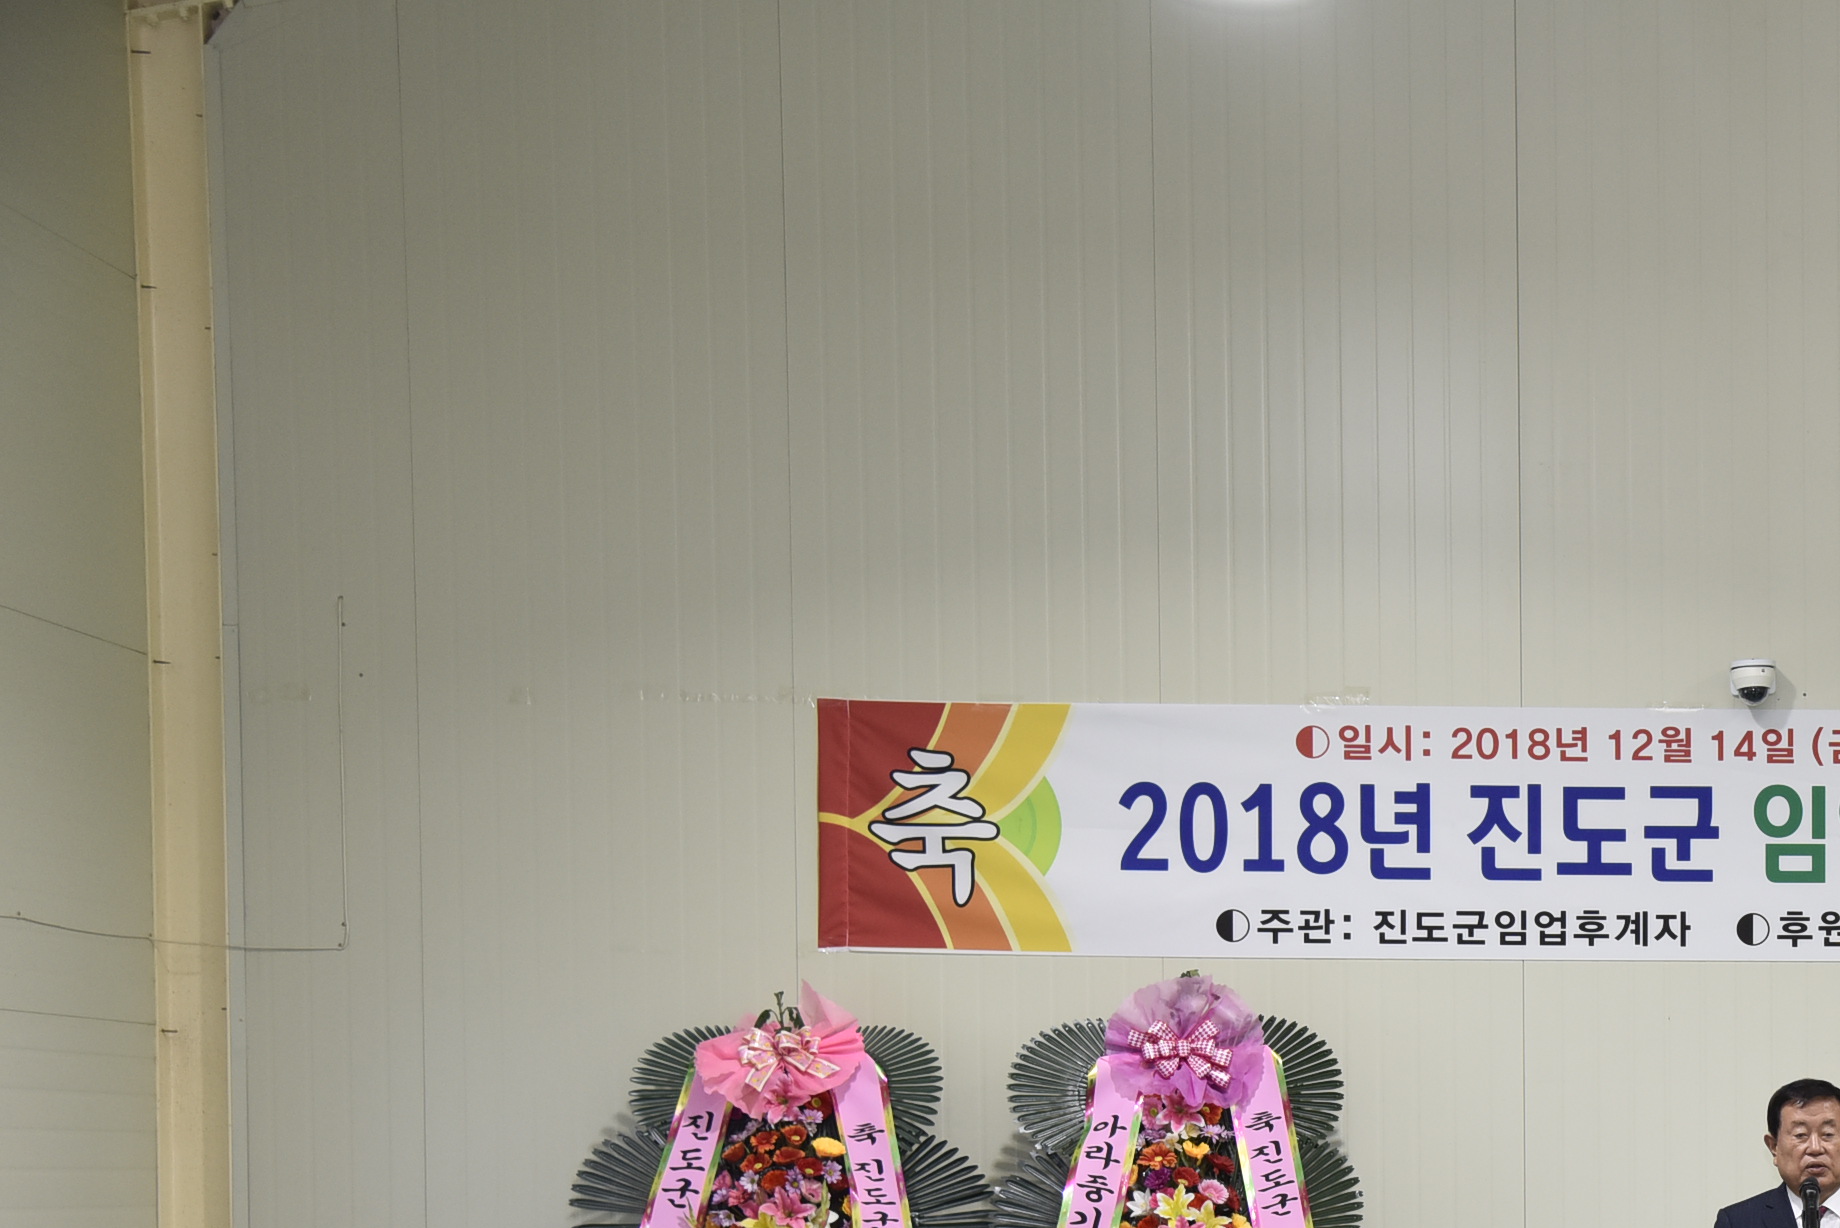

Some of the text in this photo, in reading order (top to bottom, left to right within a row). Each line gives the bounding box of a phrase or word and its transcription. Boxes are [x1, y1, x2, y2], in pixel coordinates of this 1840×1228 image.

[1338, 725, 1431, 762] 일시:
[1451, 726, 1589, 762] 2018년
[1608, 726, 1692, 764] 12월
[1711, 728, 1795, 764] 14일
[867, 747, 1000, 908] 축
[1118, 781, 1432, 882] 2018년
[1466, 783, 1720, 883] 진도군
[1256, 909, 1692, 948] 주관: 진도군임업후계자
[661, 1110, 715, 1209] 진도군
[1251, 1140, 1299, 1217] 진도군
